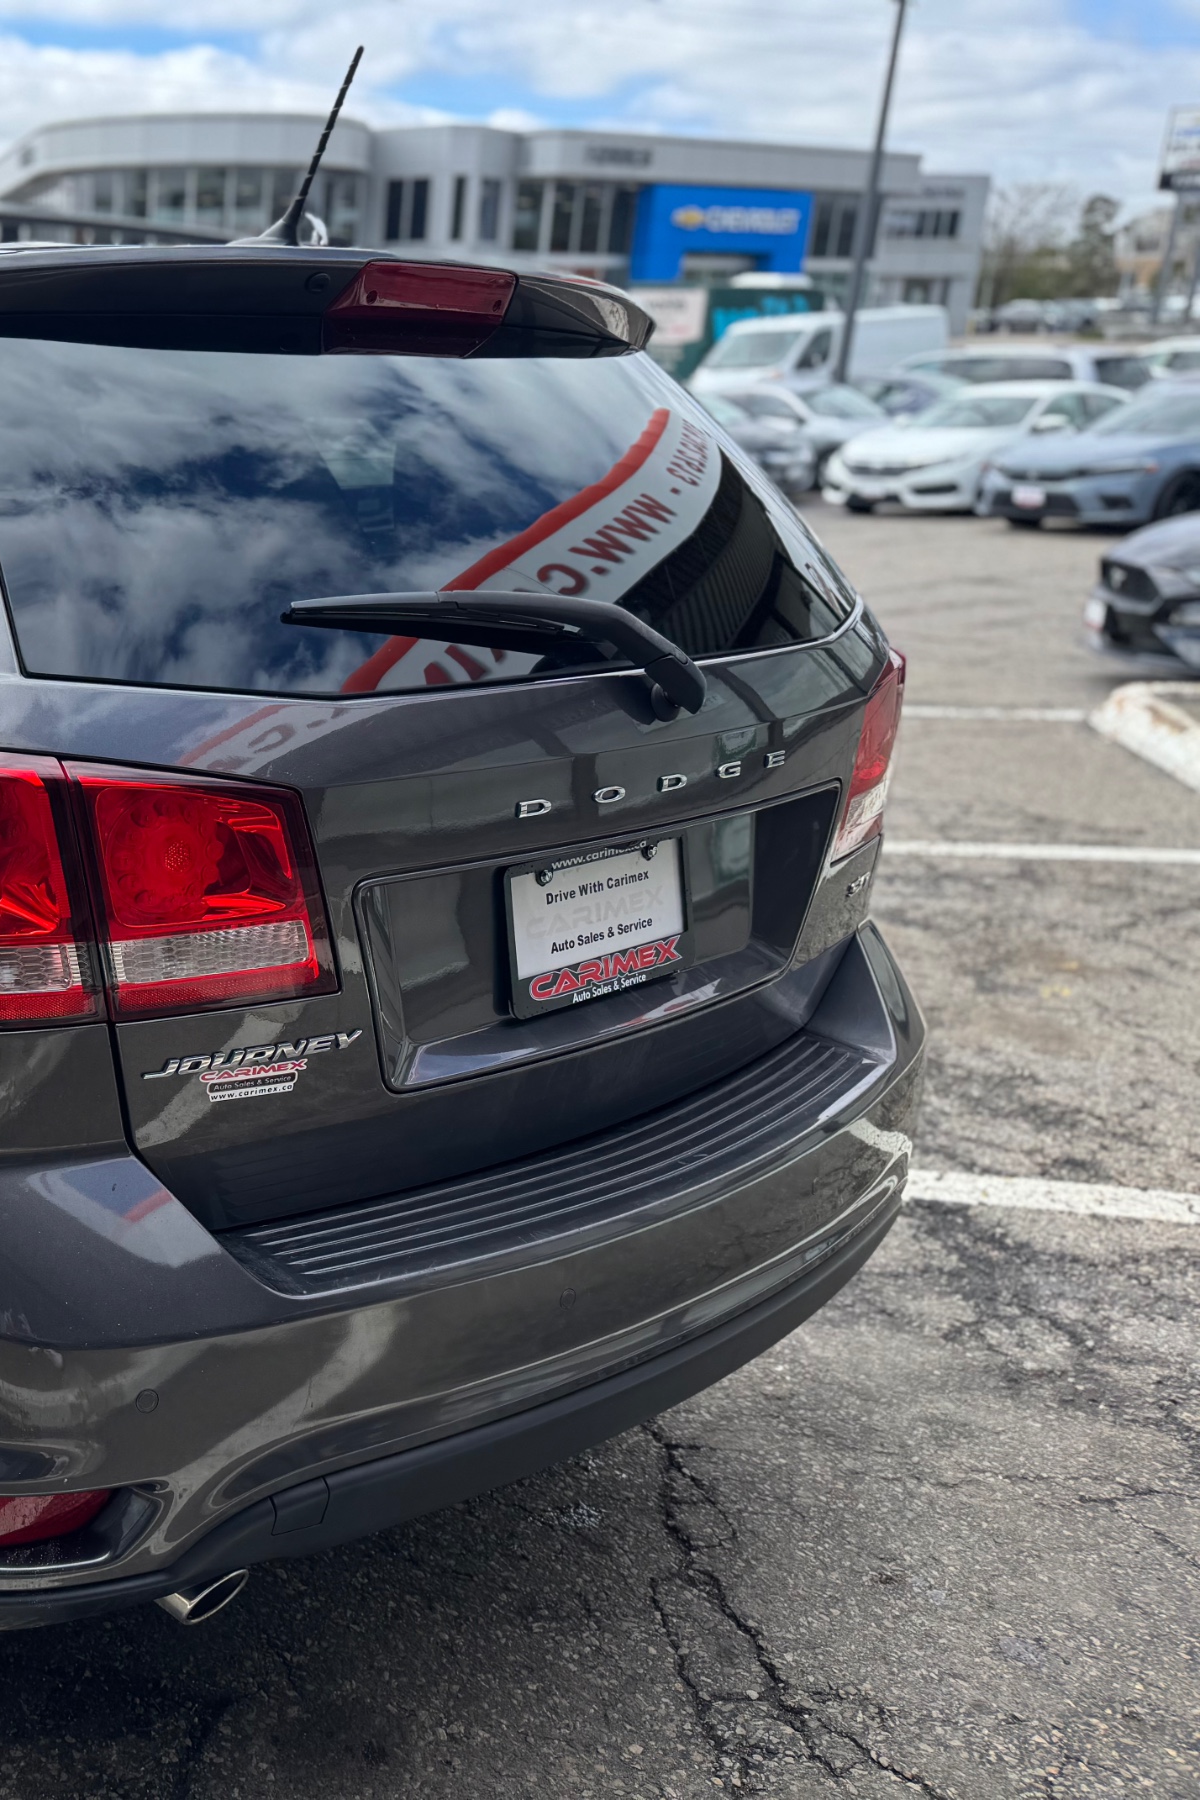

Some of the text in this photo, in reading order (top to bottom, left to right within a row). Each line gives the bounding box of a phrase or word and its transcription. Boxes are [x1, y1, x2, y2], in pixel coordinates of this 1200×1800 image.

[515, 750, 786, 818] DODGE
[545, 870, 649, 905] Drive With Carimex
[551, 917, 653, 954] Auto Sales & Service
[529, 934, 683, 1001] CARIMEX
[572, 974, 647, 1004] Auto Sales & Service
[142, 1028, 363, 1080] JOURNEY
[200, 1059, 308, 1082] CARIMEX
[210, 1084, 293, 1101] www.carimex.ca
[213, 1083, 232, 1091] Auto
[234, 1080, 255, 1088] Sales
[265, 1075, 292, 1084] Service
